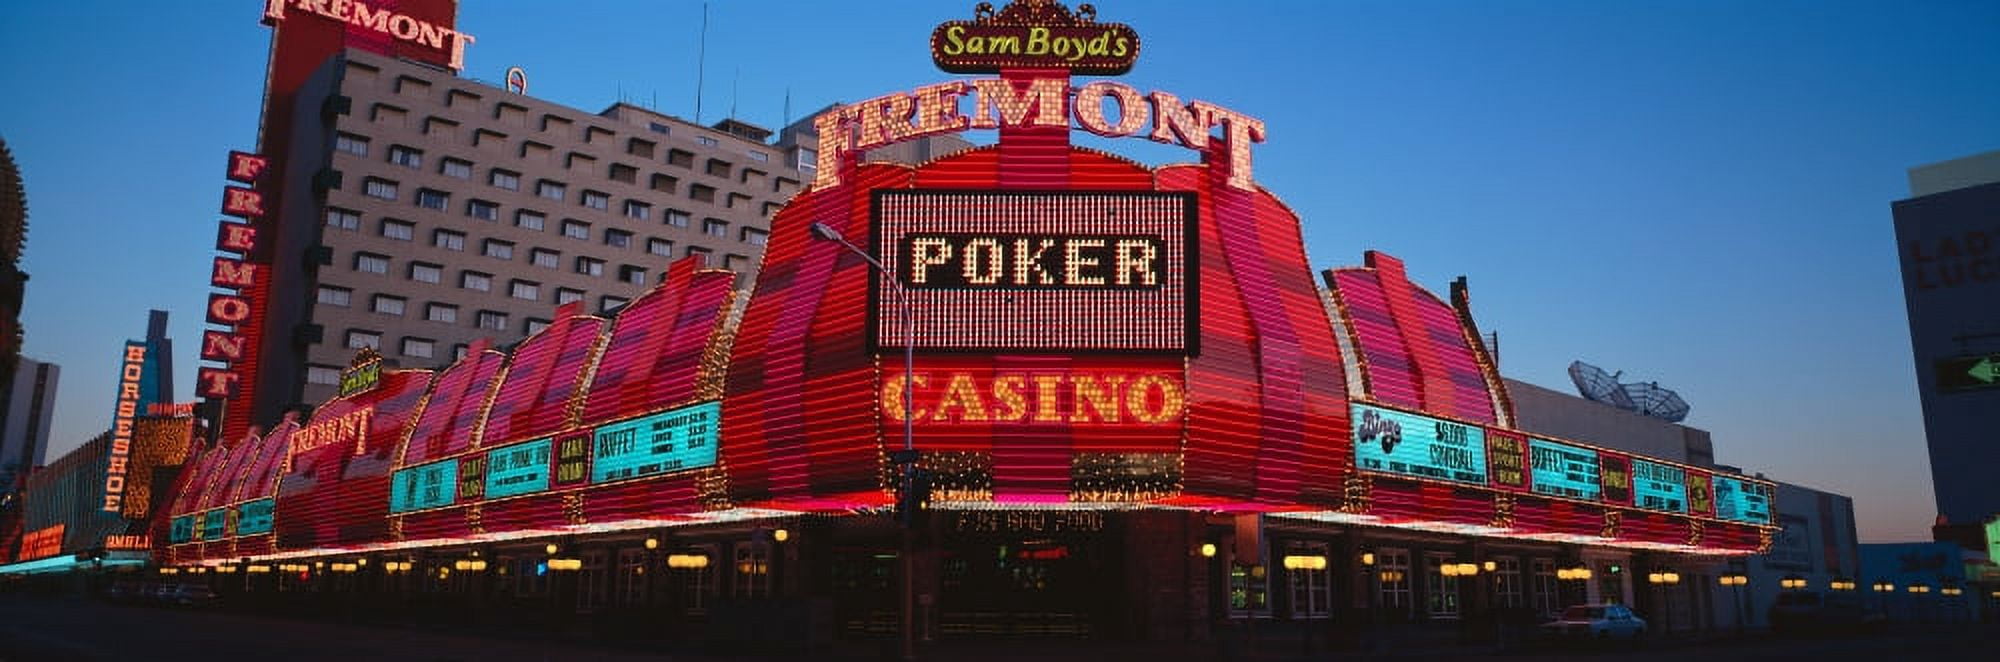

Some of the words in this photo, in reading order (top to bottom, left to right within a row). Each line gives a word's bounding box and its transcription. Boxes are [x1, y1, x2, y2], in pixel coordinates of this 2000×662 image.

[264, 0, 474, 71] FREMONT
[943, 26, 1021, 56] Sam
[1025, 26, 1130, 62] Boyd's
[812, 77, 1266, 193] FREMONT
[203, 154, 267, 397] FREMONT
[910, 236, 1158, 286] POKER
[104, 344, 147, 512] HORSESHOE
[881, 373, 1184, 424] CASINO
